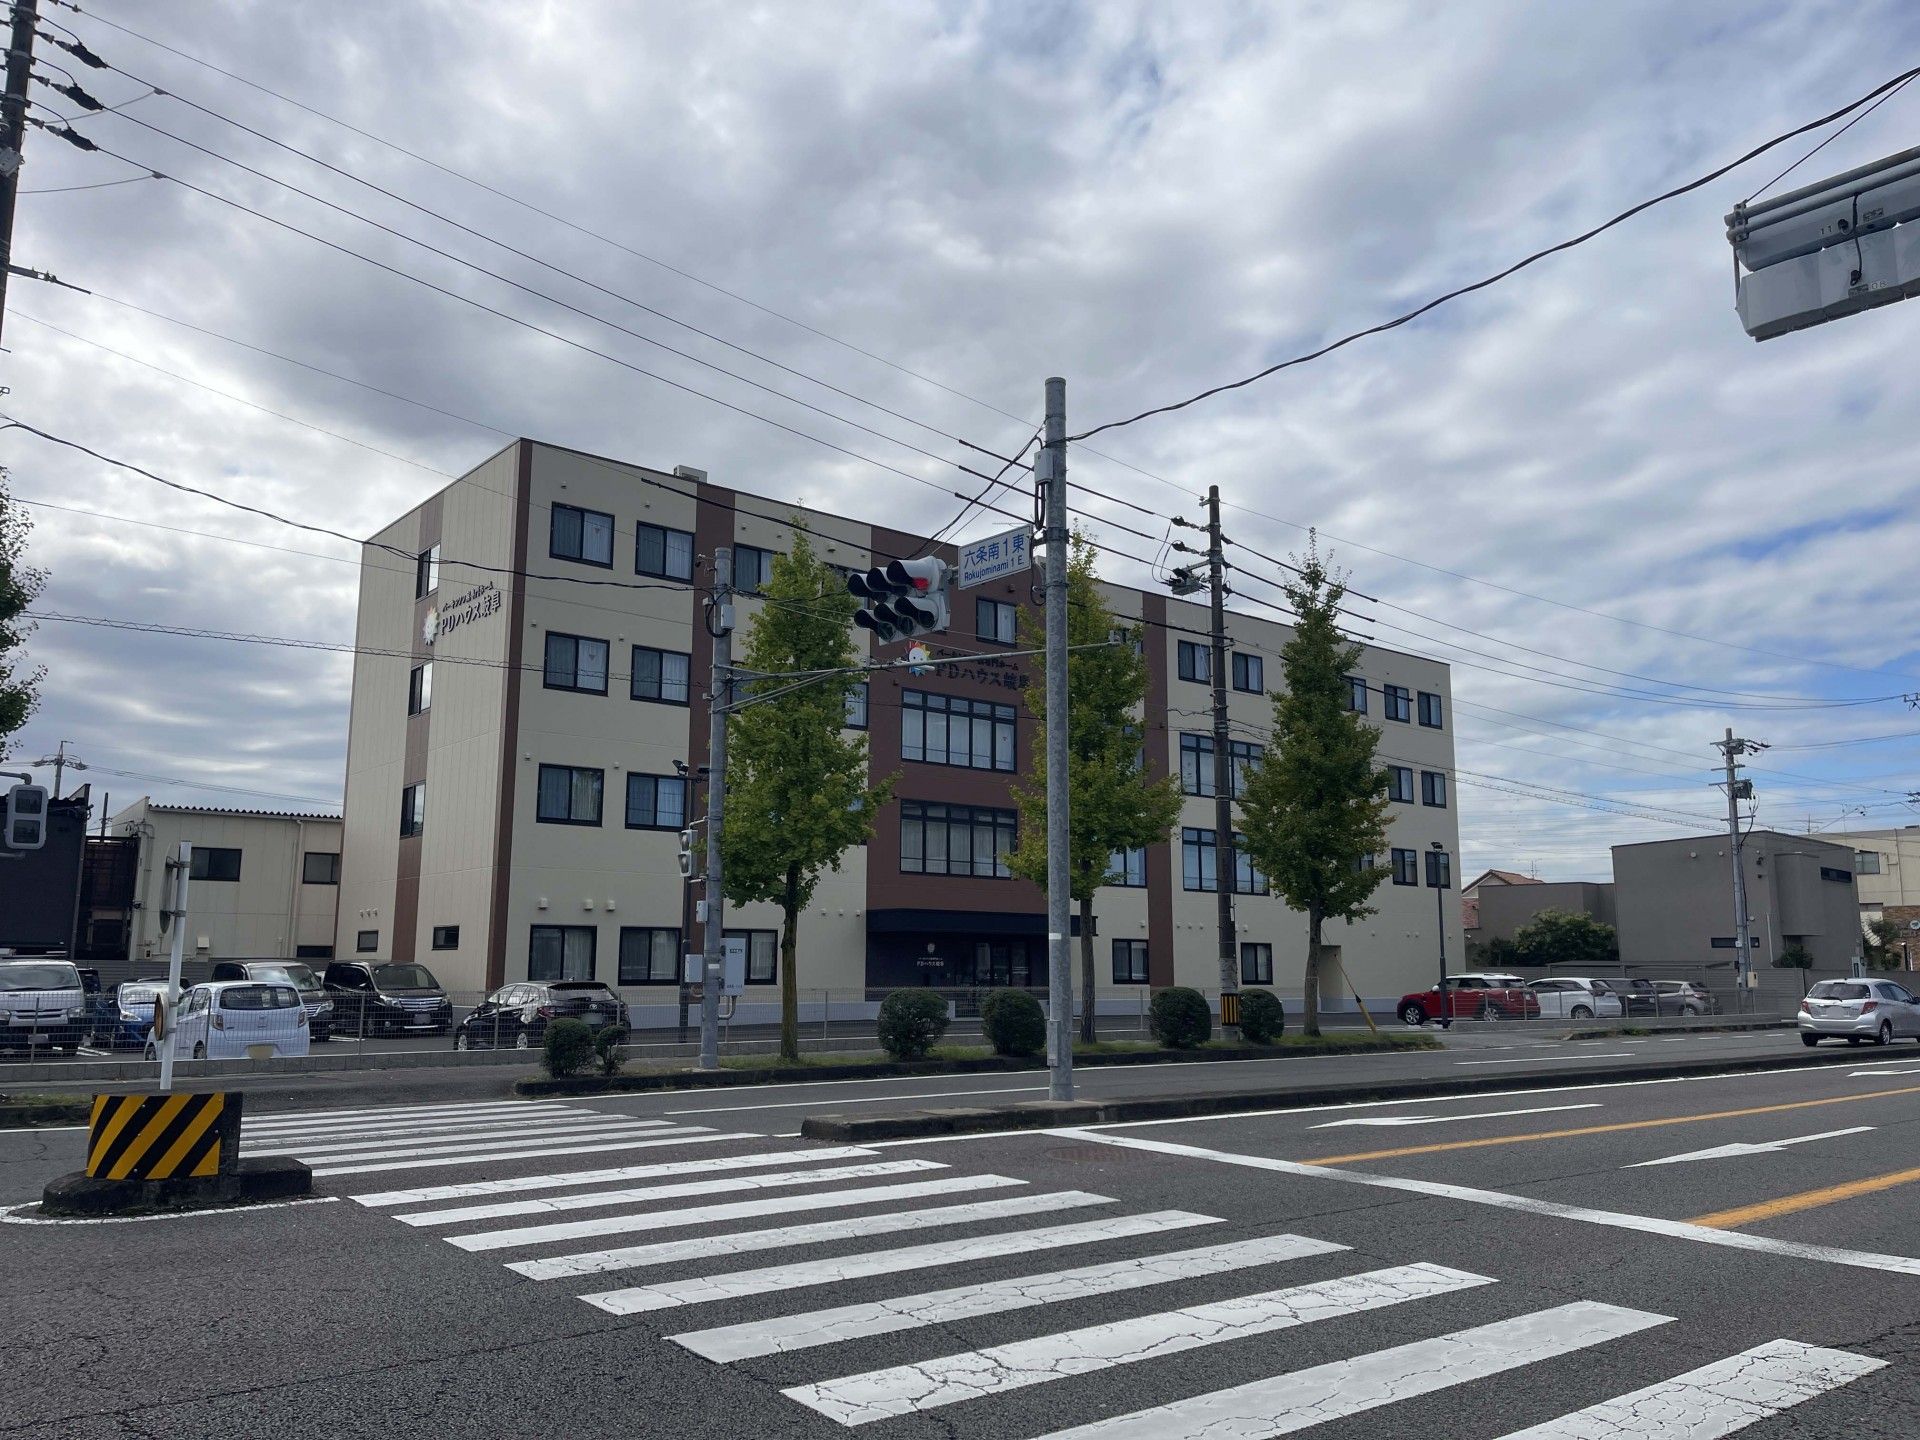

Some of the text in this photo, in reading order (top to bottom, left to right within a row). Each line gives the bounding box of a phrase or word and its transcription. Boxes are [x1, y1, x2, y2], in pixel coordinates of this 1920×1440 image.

[964, 533, 1025, 569] 六条南1東
[964, 561, 1009, 582] Rokujominami
[1017, 555, 1024, 565] E
